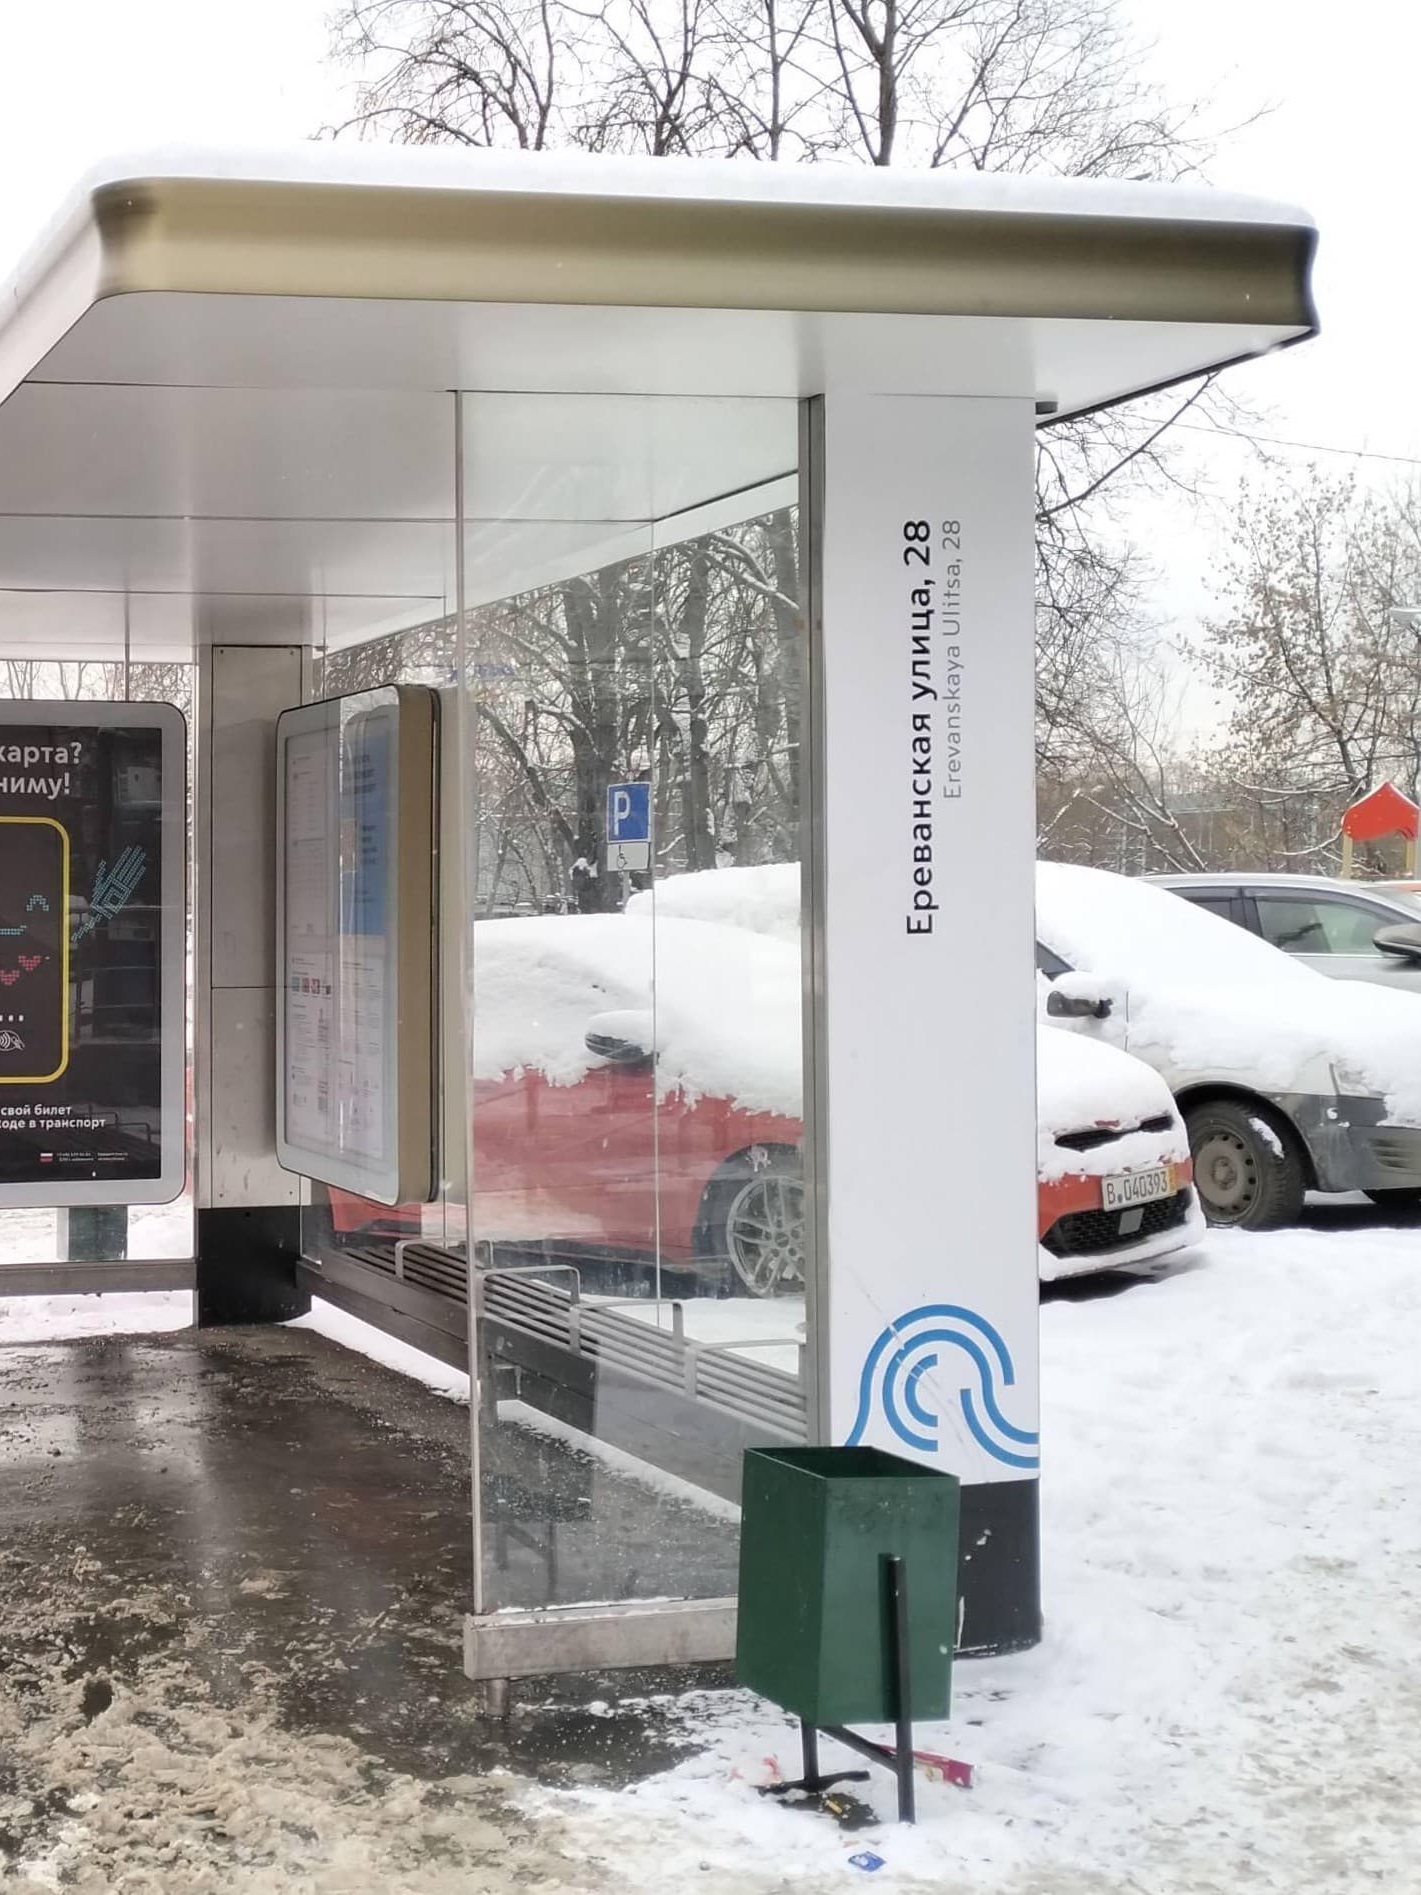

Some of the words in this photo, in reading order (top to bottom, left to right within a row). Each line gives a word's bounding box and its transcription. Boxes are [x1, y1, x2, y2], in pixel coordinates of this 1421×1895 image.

[903, 520, 930, 566] 28
[942, 520, 961, 549] 28
[942, 558, 963, 636] Ulitsa,
[911, 579, 938, 701] улица,
[942, 645, 964, 798] Erevanskaya
[613, 791, 631, 836] P
[906, 714, 939, 934] Ереванская
[0, 1104, 31, 1116] свой
[34, 1103, 73, 1116] билет
[28, 1119, 37, 1129] в
[39, 1118, 107, 1131] транспорт
